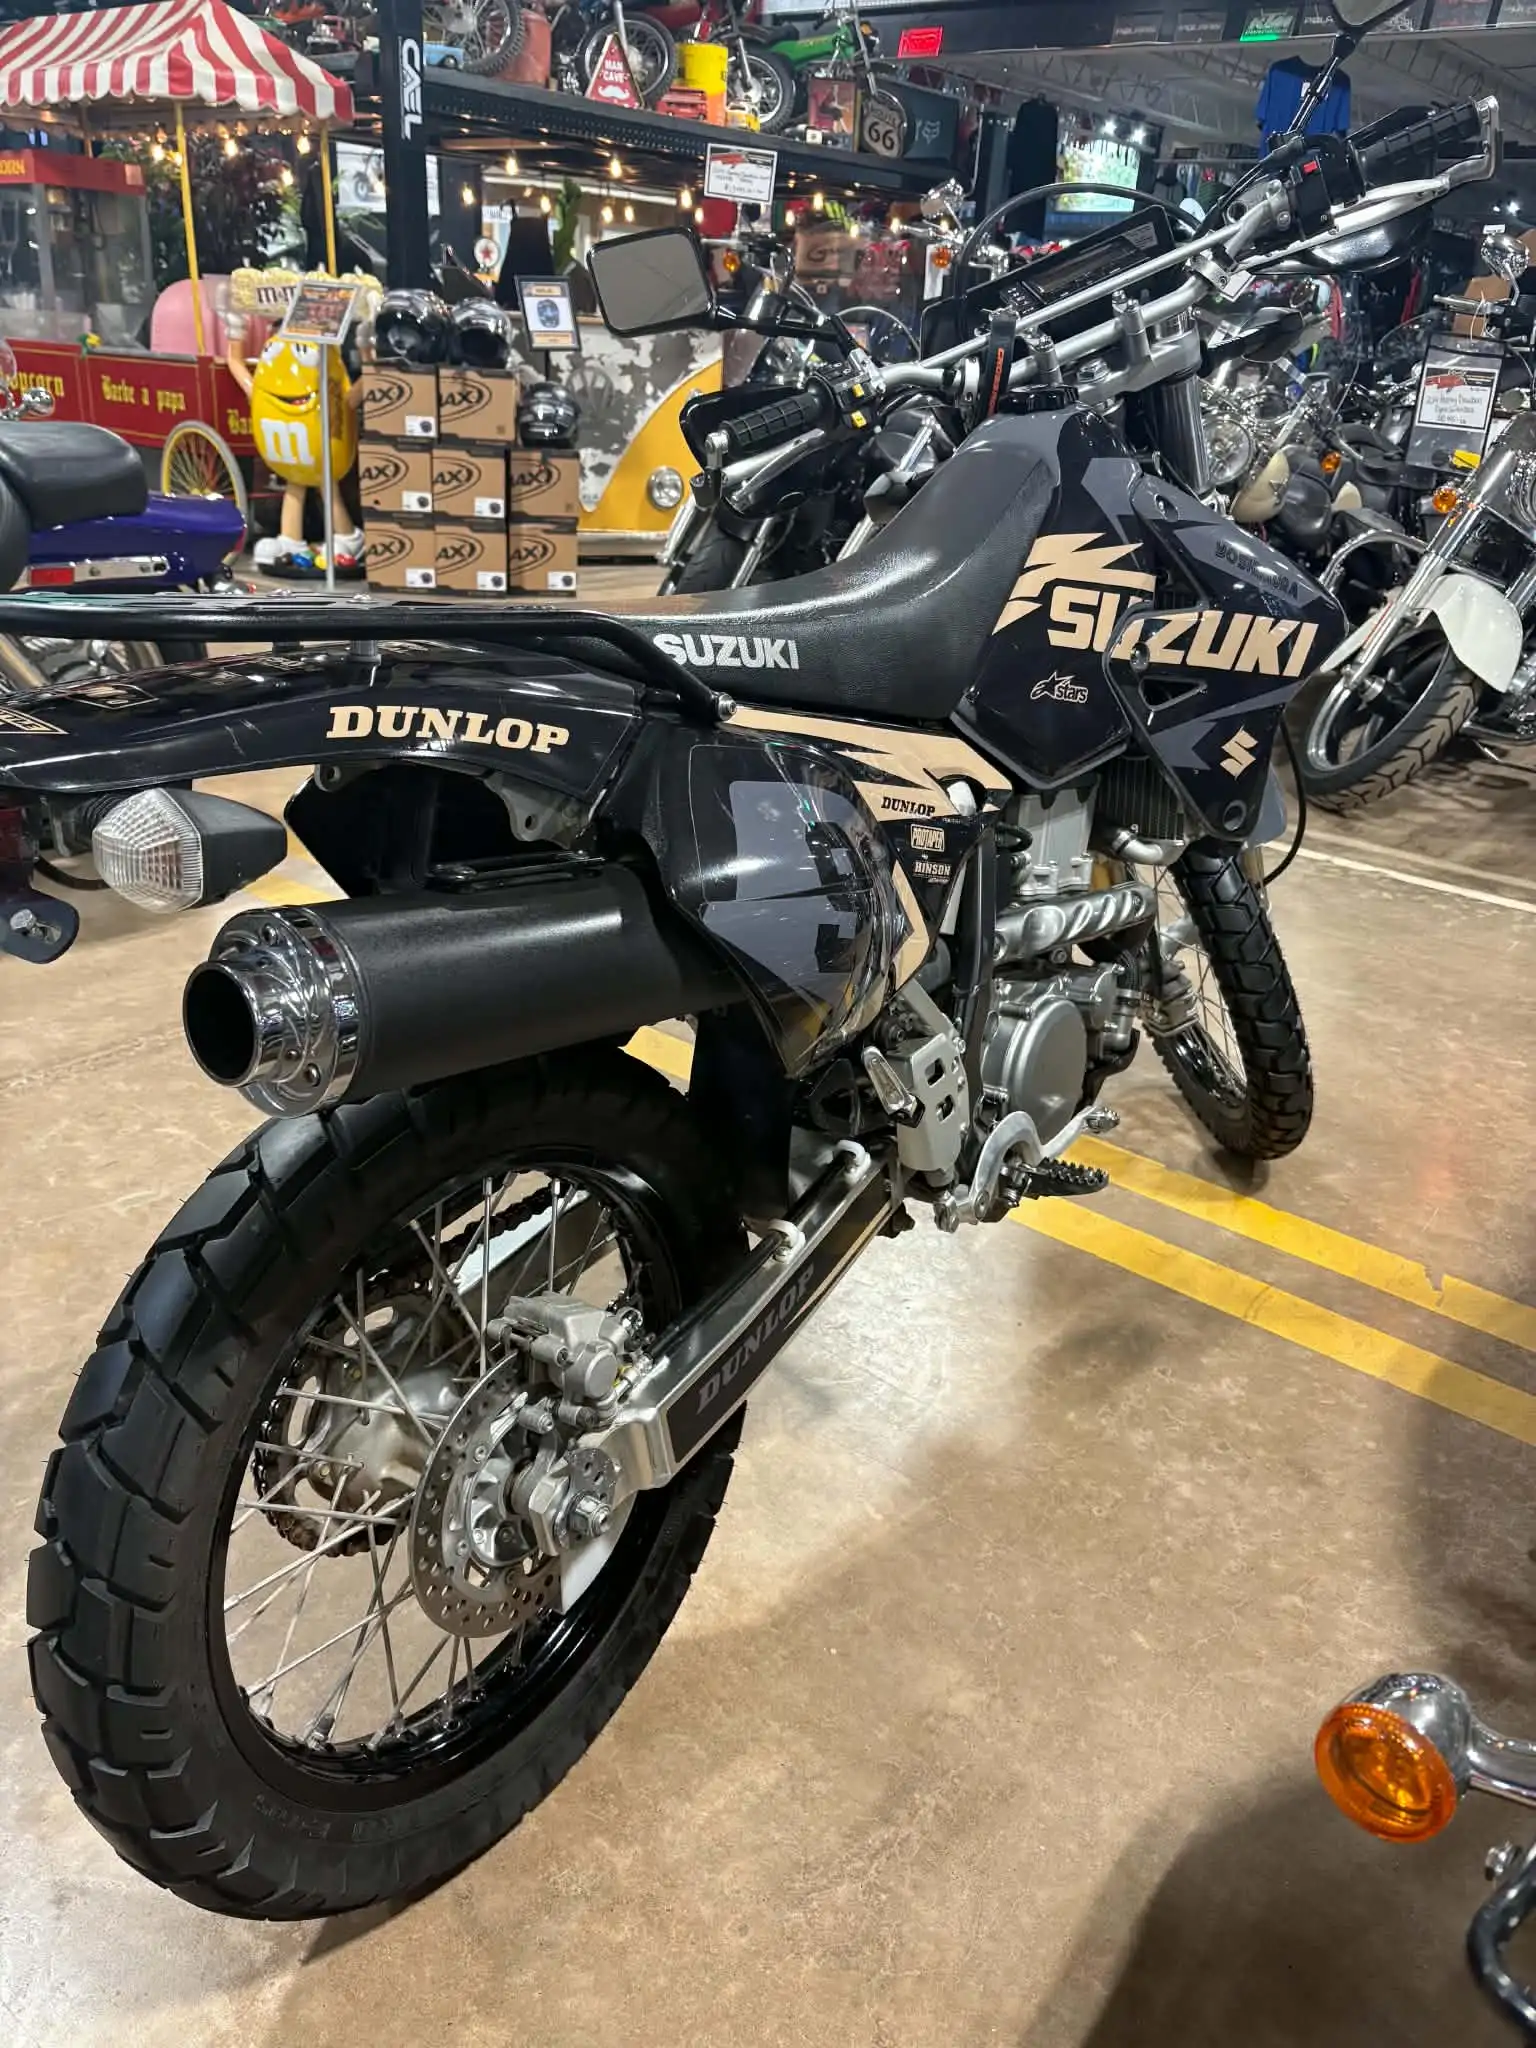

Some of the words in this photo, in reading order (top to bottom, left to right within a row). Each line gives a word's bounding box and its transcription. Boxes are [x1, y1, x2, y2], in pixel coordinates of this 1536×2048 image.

[868, 121, 895, 151] 66
[156, 389, 187, 414] papa
[260, 417, 315, 465] m
[1047, 585, 1319, 678] SUZUKI
[652, 633, 800, 670] SUZUKI
[325, 704, 571, 756] DUNLOP
[881, 796, 936, 817] DUNLOP
[914, 861, 951, 877] HINSON
[696, 1262, 815, 1415] DUNLOP
